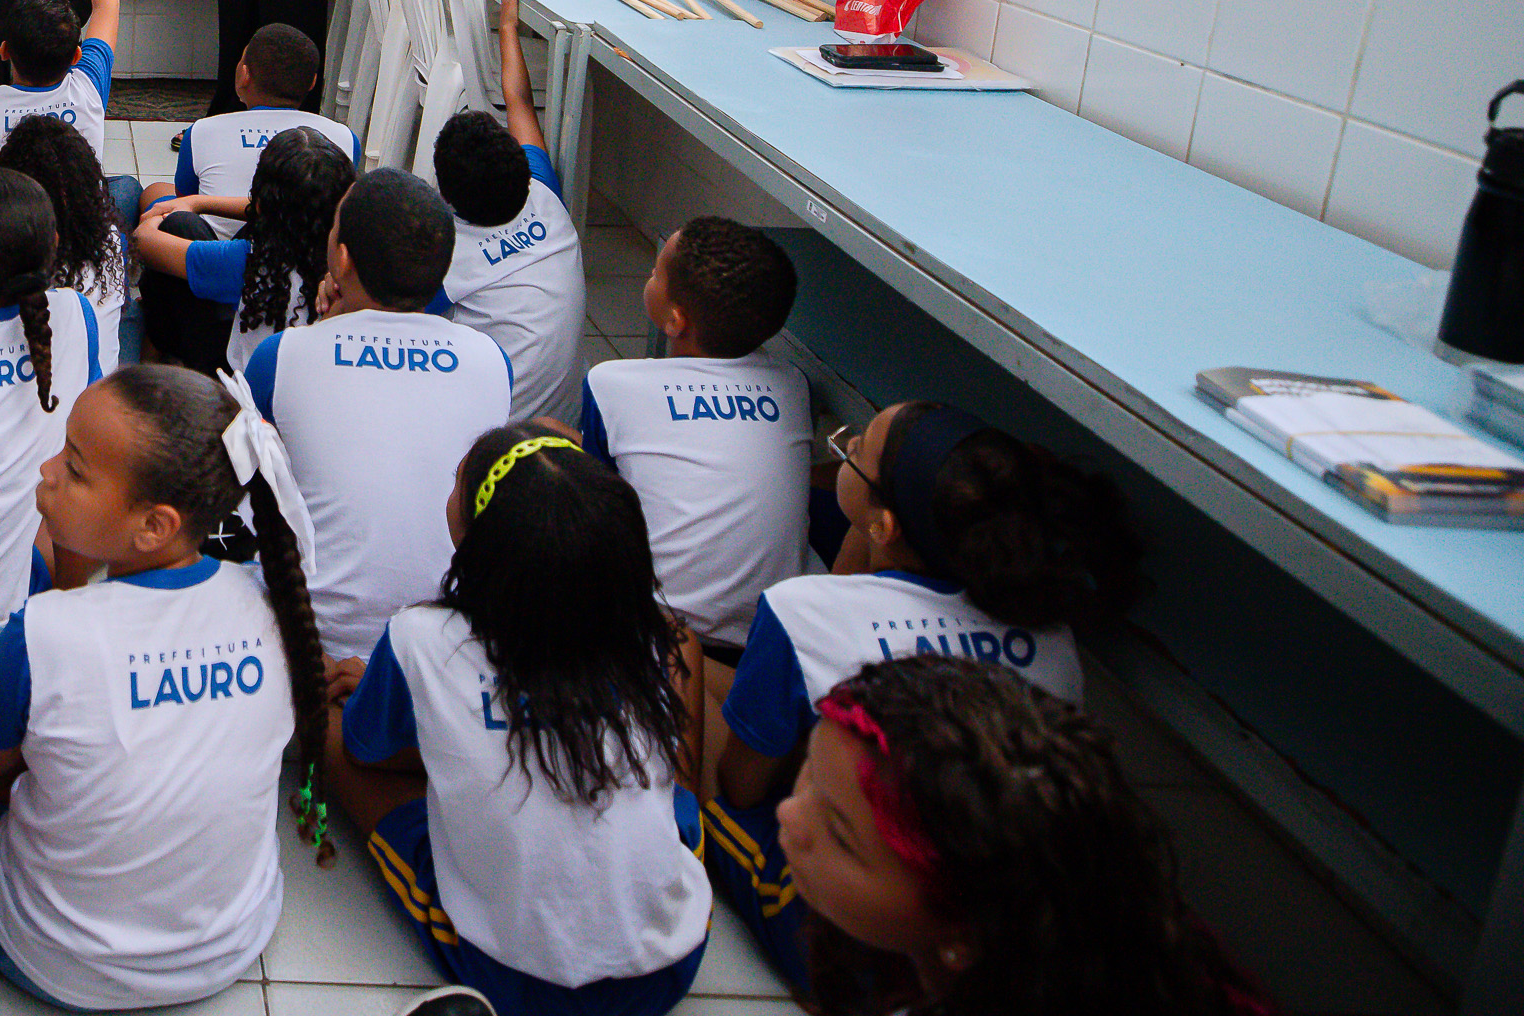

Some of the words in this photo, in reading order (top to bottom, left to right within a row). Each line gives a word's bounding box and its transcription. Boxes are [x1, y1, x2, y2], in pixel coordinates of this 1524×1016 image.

[5, 102, 75, 113] PREFEITURA
[482, 221, 546, 266] LAURO
[335, 334, 454, 347] PREFEITURA
[334, 343, 459, 373] LAURO
[666, 395, 780, 422] LAURO
[129, 637, 263, 665] PREFEITURA
[130, 655, 264, 711] LAURO
